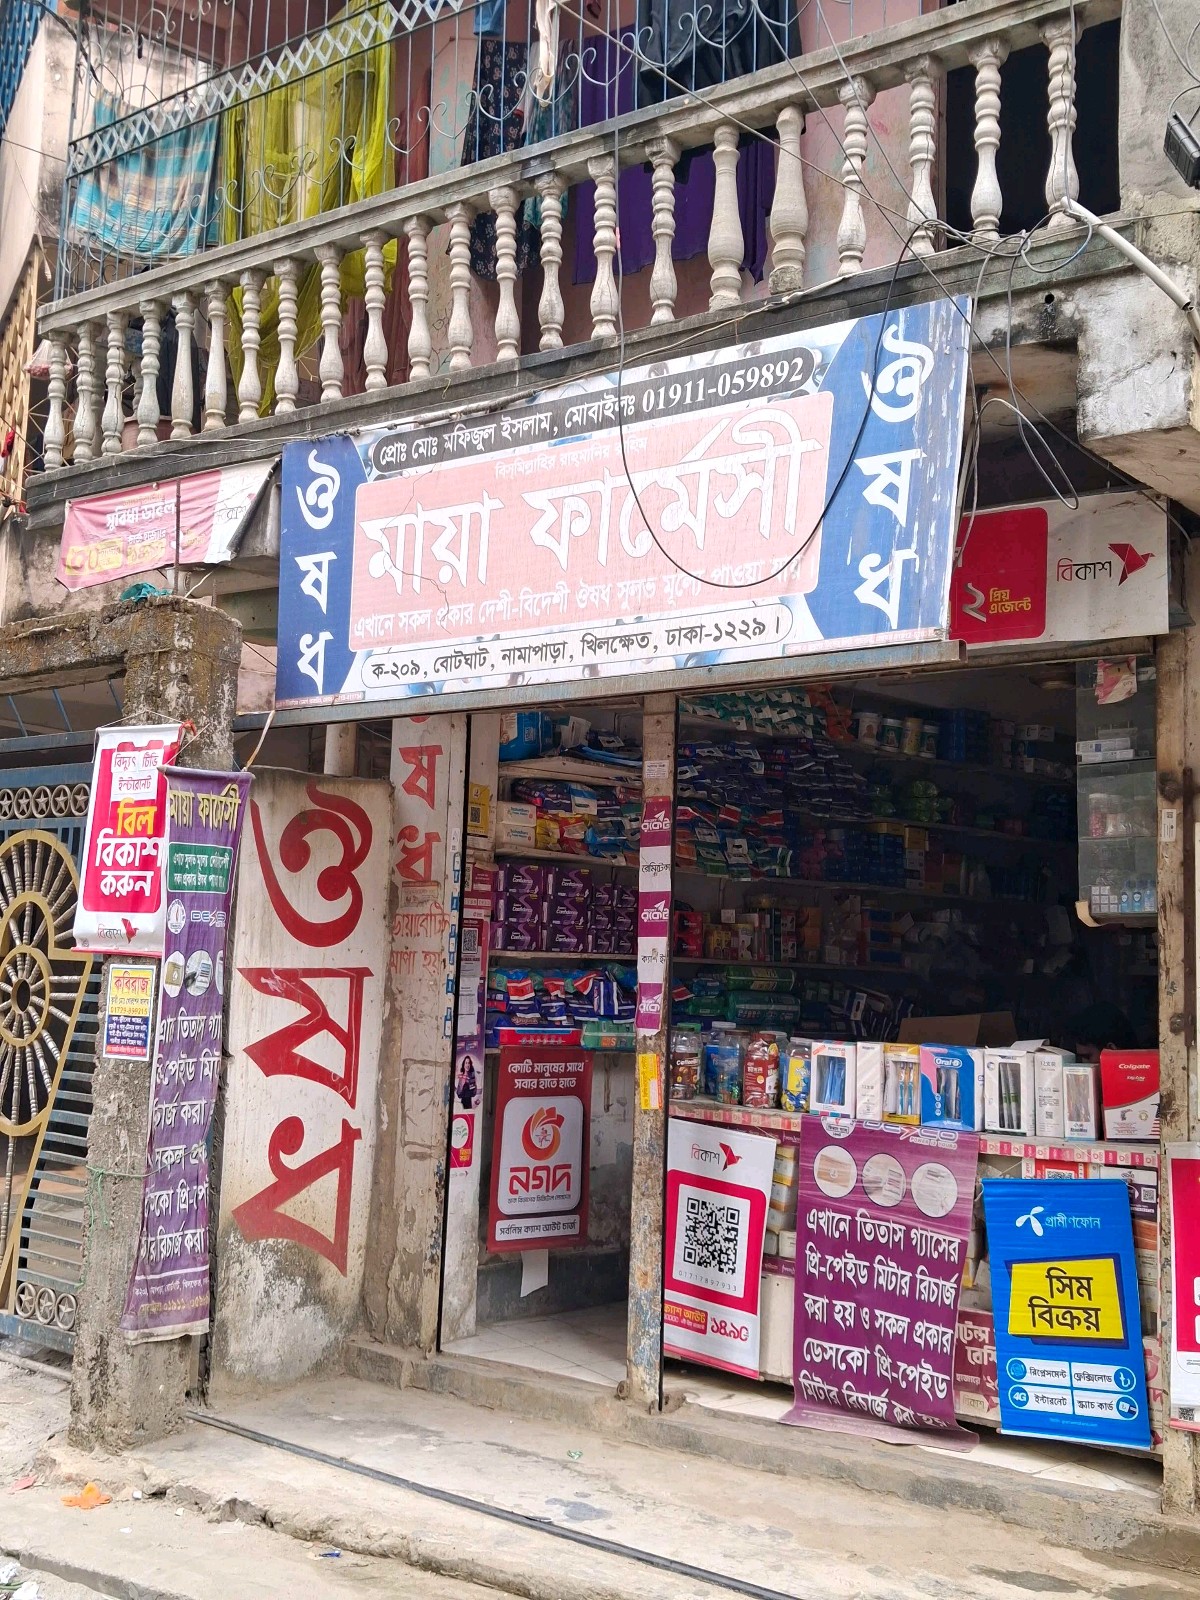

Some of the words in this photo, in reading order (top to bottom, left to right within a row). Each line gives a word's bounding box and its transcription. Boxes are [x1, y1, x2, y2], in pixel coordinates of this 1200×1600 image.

[380, 441, 407, 466] প্রোঃ
[412, 437, 438, 460] মোঃ
[444, 424, 497, 452] মফিজুল
[500, 410, 558, 440] ইসলাম,
[642, 355, 805, 414] 01911-059892
[359, 489, 507, 596] মায়া
[521, 407, 824, 573] ফার্মেসী
[1056, 557, 1112, 582] বিকাশ
[354, 613, 393, 640] এখানে
[398, 608, 433, 631] সকল
[436, 603, 474, 629] প্রকার
[478, 580, 571, 625] দেশী-বিদেশী
[575, 578, 613, 609] ঔষধ
[616, 575, 656, 609] সুলভ
[711, 559, 766, 588] পাওয়া
[434, 647, 495, 675] বোটঘাট,
[500, 640, 575, 670] নামাপাড়া,
[581, 631, 660, 660] খিলক্ষেত,
[114, 754, 136, 772] বিদ্যুৎ
[141, 752, 160, 768] টিভি
[118, 776, 152, 792] ইন্টারনেট
[117, 797, 157, 836] বিল
[198, 783, 241, 833] ফার্মেসী
[95, 828, 167, 868] বিকাশ
[100, 871, 155, 898] করুন
[97, 924, 123, 940] বিকাশ
[389, 951, 418, 975] মাপা
[114, 970, 150, 997] কবিরাজ
[508, 1059, 532, 1074] কোটি
[533, 1061, 565, 1077] মানুষের
[566, 1060, 584, 1073] সাথে
[935, 1057, 960, 1068] Oral-B
[1118, 1063, 1151, 1071] Colgate
[514, 1077, 538, 1090] সবার
[539, 1078, 558, 1090] হাতে
[559, 1077, 577, 1089] হাতে
[690, 1143, 721, 1166] বিকাশ
[508, 1164, 572, 1195] নগদ
[523, 1223, 541, 1234] ক্যাশ
[542, 1221, 561, 1233] আউট
[562, 1219, 576, 1232] চার্জ
[1045, 1212, 1101, 1230] গ্রামীণফোন
[806, 1208, 851, 1240] এখানে
[855, 1207, 907, 1251] তিতাস
[910, 1226, 961, 1265] গ্যাসের
[805, 1241, 870, 1289] প্রি-পেইড
[873, 1254, 912, 1298] মিটার
[915, 1264, 959, 1310] রিচার্জ
[1045, 1266, 1093, 1301] সিম
[683, 1309, 706, 1324] আউট
[803, 1292, 829, 1325] করা
[831, 1299, 856, 1331] হয়
[860, 1307, 870, 1330] ও
[874, 1308, 911, 1344] সকল
[912, 1318, 954, 1356] প্রকার
[1028, 1296, 1101, 1333] বিক্রয়
[803, 1337, 871, 1376] ডেসকো
[874, 1343, 951, 1402] প্রি-পেইড
[1029, 1366, 1067, 1379] রিপ্লেসমেন্ট
[799, 1369, 841, 1406] মিটার
[842, 1380, 889, 1420] রিচার্জ
[891, 1399, 919, 1427] করা
[1013, 1391, 1027, 1402] 4G
[1034, 1393, 1067, 1407] ইন্টারনেট
[1097, 1400, 1114, 1412] কার্ড
